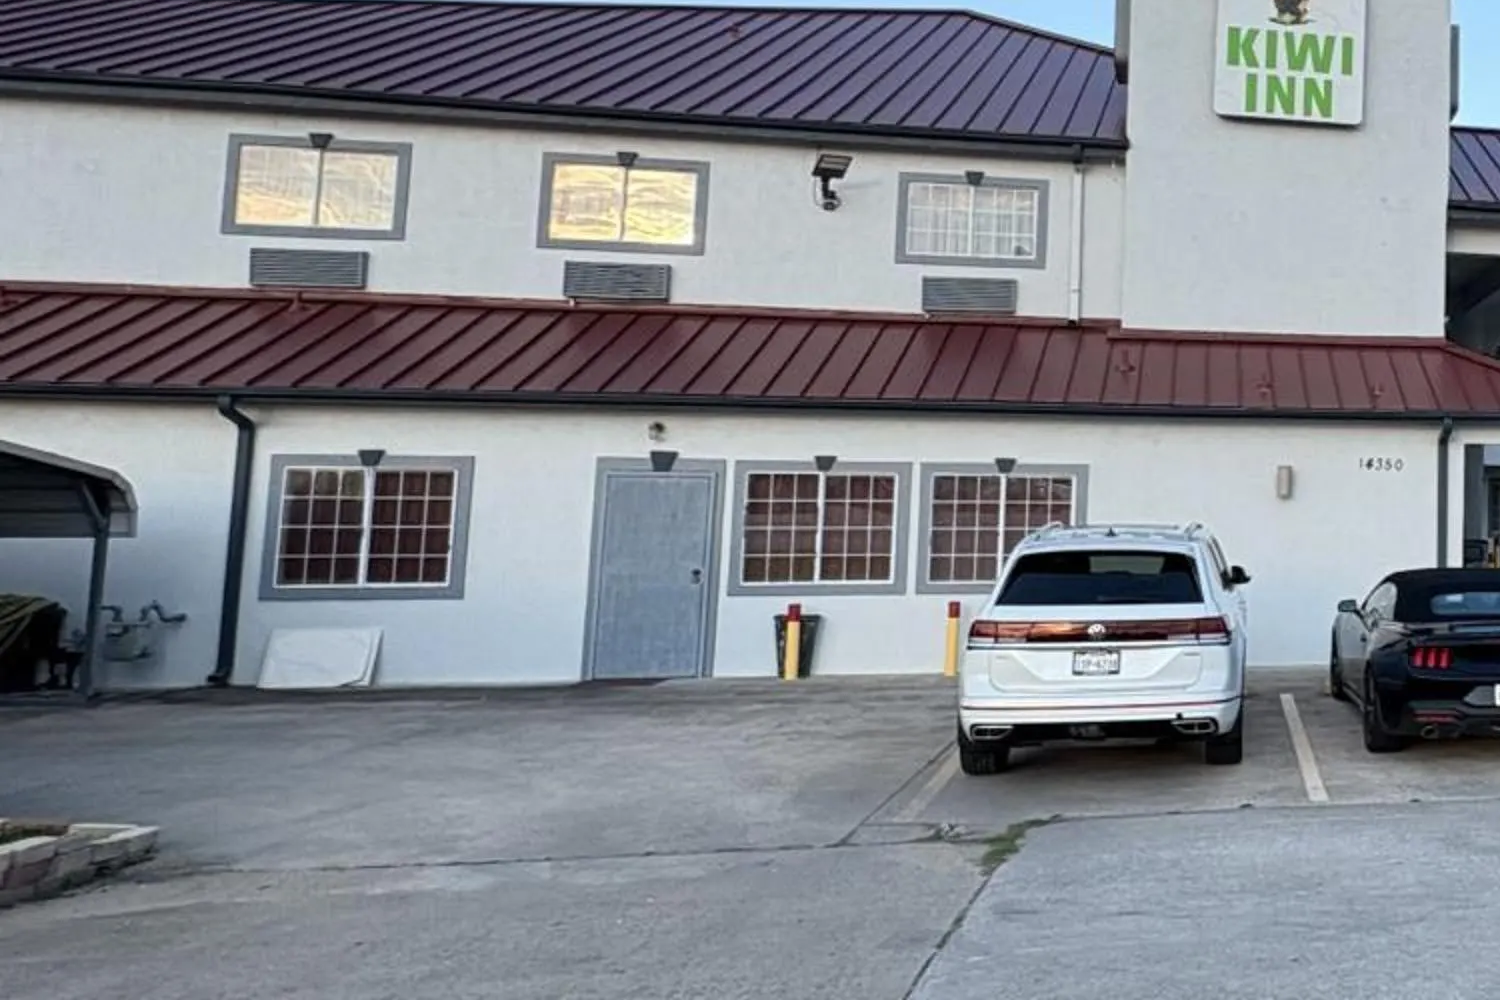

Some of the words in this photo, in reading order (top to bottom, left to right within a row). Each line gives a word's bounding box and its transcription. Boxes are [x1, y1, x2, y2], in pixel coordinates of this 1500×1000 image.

[1226, 26, 1354, 76] KIWI
[1244, 73, 1333, 118] INN
[1359, 457, 1405, 472] 14350
